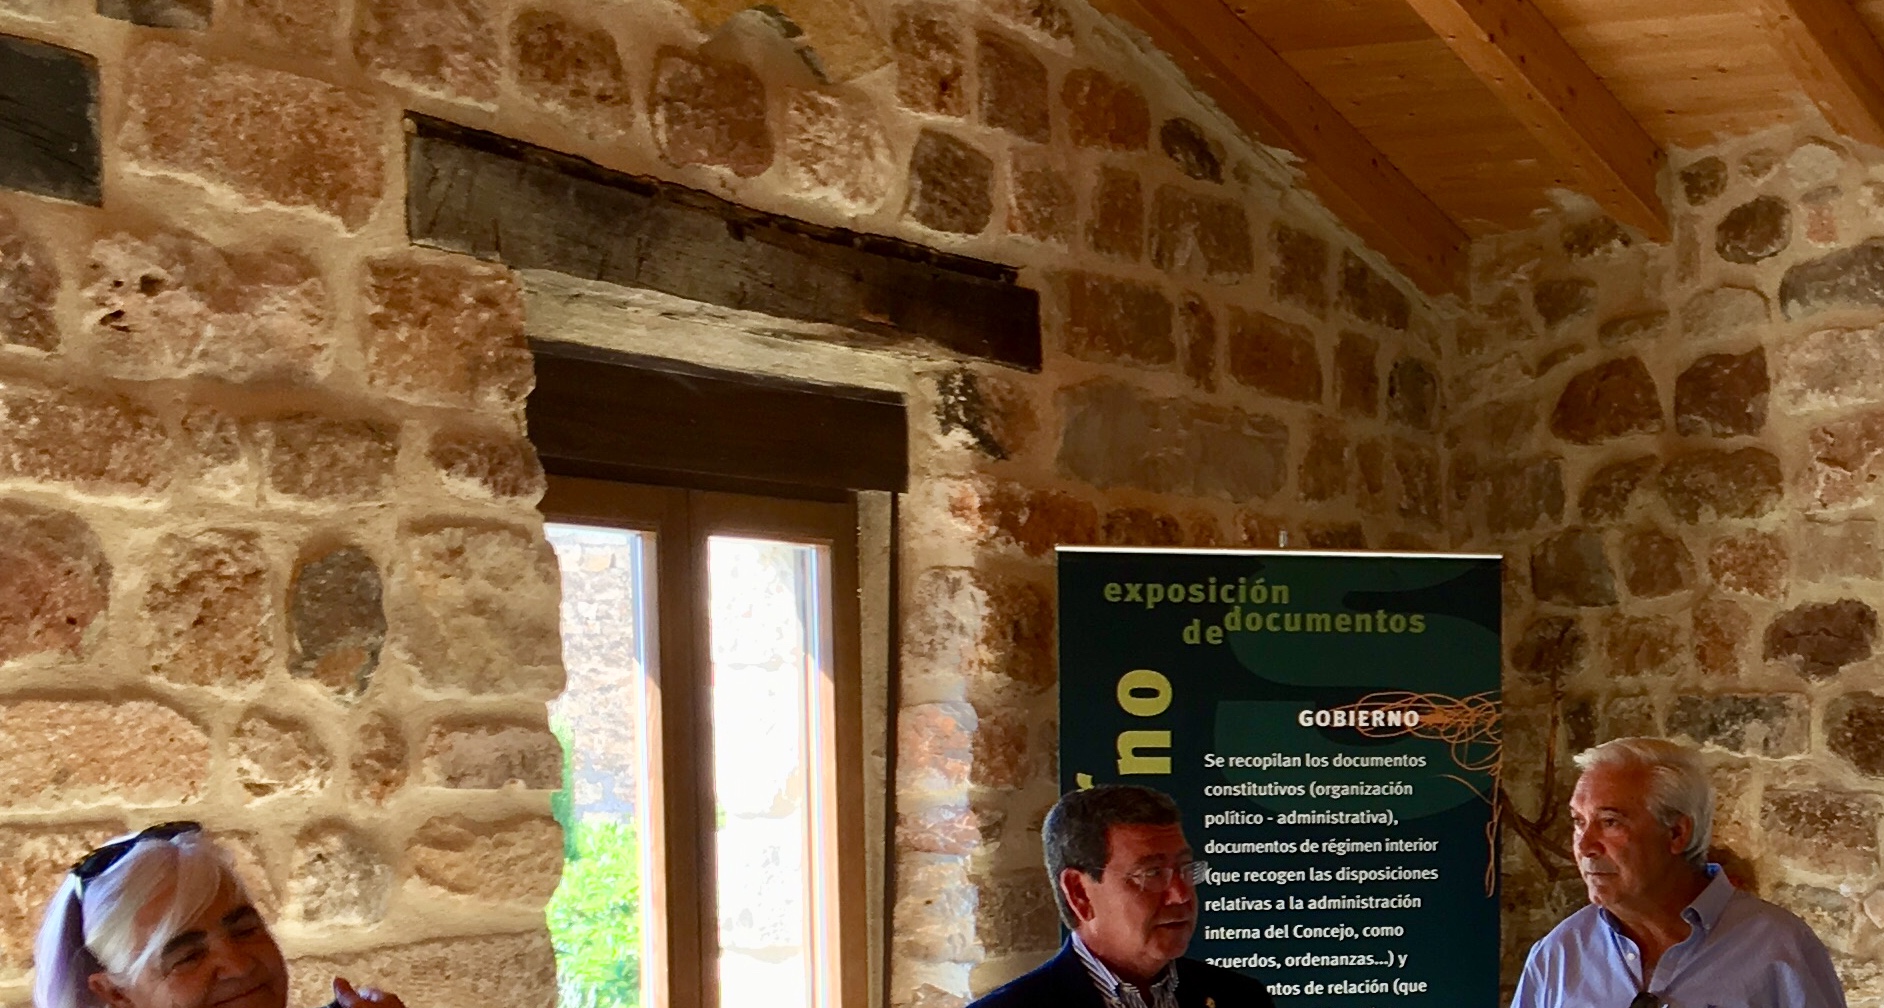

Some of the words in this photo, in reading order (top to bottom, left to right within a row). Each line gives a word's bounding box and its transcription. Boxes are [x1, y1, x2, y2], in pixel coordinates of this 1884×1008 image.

[1103, 576, 1290, 610] exposición
[1182, 619, 1224, 646] de
[1224, 605, 1427, 634] documentos
[1298, 709, 1421, 728] GOBIERNO
[1203, 753, 1226, 768] Se
[1228, 752, 1302, 771] recopilan
[1305, 752, 1330, 768] los
[1332, 752, 1427, 768] documentos
[1203, 781, 1306, 797] constitutivos
[1309, 780, 1413, 799] (organización
[1204, 810, 1264, 829] político
[1276, 809, 1399, 827] administrativa),
[1204, 839, 1298, 854] documentos
[1299, 838, 1320, 853] de
[1321, 837, 1383, 856] régimen
[1384, 837, 1439, 852] interior
[1204, 866, 1241, 886] (que
[1243, 870, 1306, 885] recogen
[1309, 866, 1333, 882] las
[1335, 865, 1439, 884] disposiciones
[1204, 896, 1273, 912] relativas
[1275, 899, 1286, 911] a
[1289, 895, 1305, 910] la
[1307, 893, 1422, 910] administración
[1204, 925, 1261, 940] interna
[1263, 924, 1290, 939] del
[1292, 923, 1360, 942] Concejo,
[1361, 925, 1405, 938] como
[1284, 949, 1395, 968] ordenanzas...)
[1397, 953, 1409, 969] y
[1303, 980, 1325, 996] de
[1327, 978, 1389, 995] relación
[1392, 977, 1428, 996] (que
